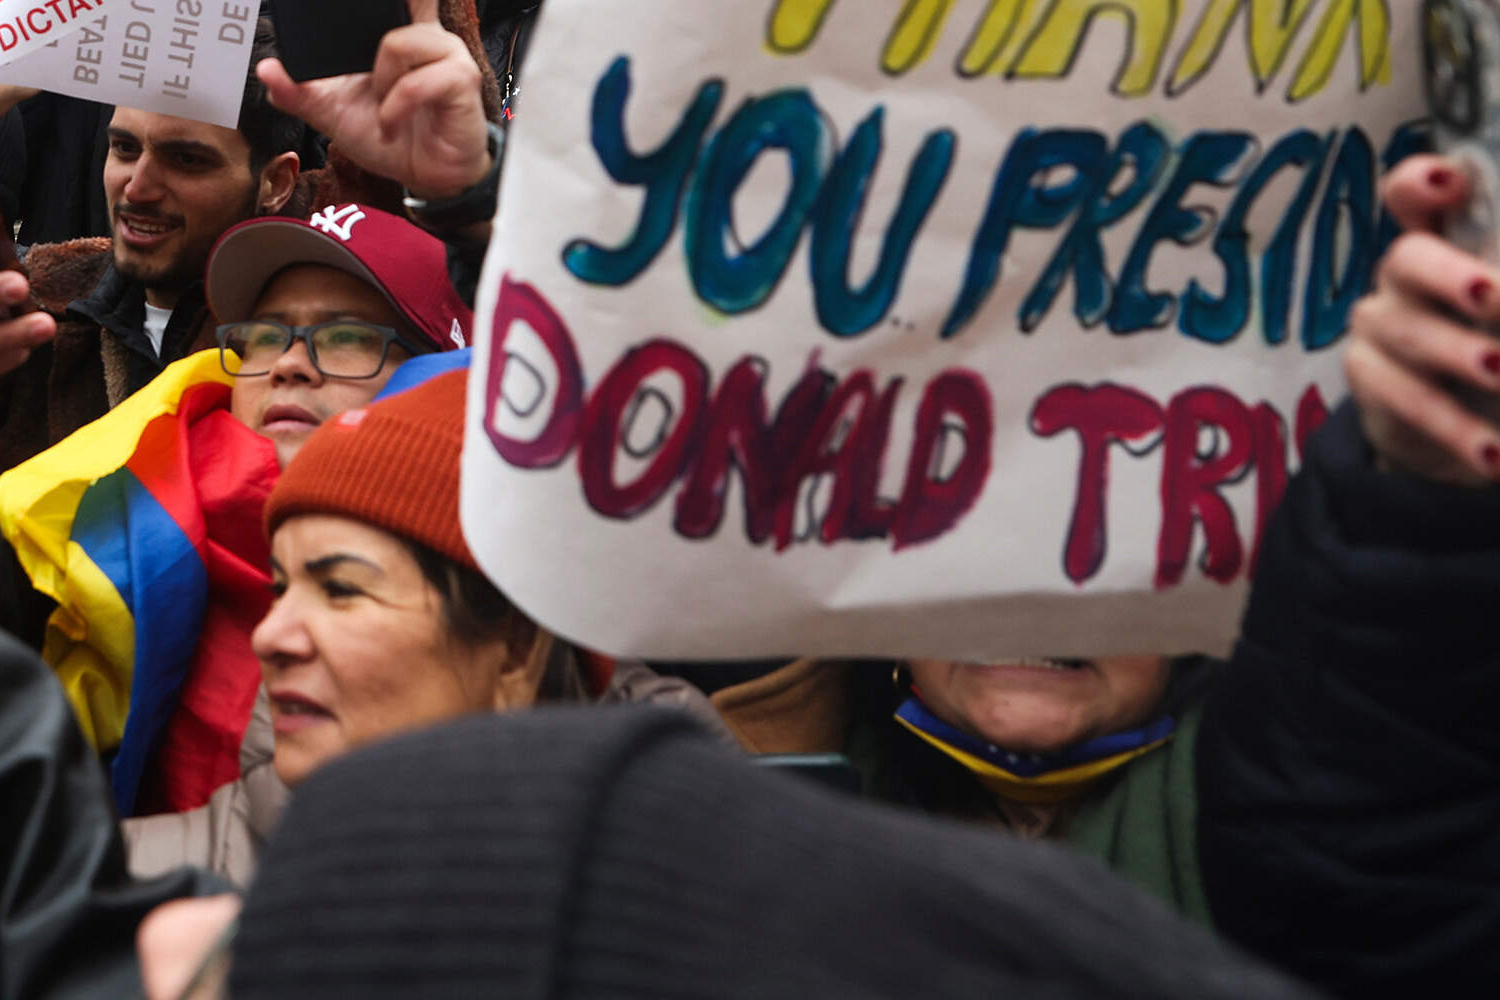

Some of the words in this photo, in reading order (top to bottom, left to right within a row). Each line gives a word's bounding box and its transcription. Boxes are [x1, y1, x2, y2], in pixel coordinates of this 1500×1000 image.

[562, 54, 956, 338] YOU
[938, 115, 1434, 351] PRESID
[482, 272, 994, 554] DONALD
